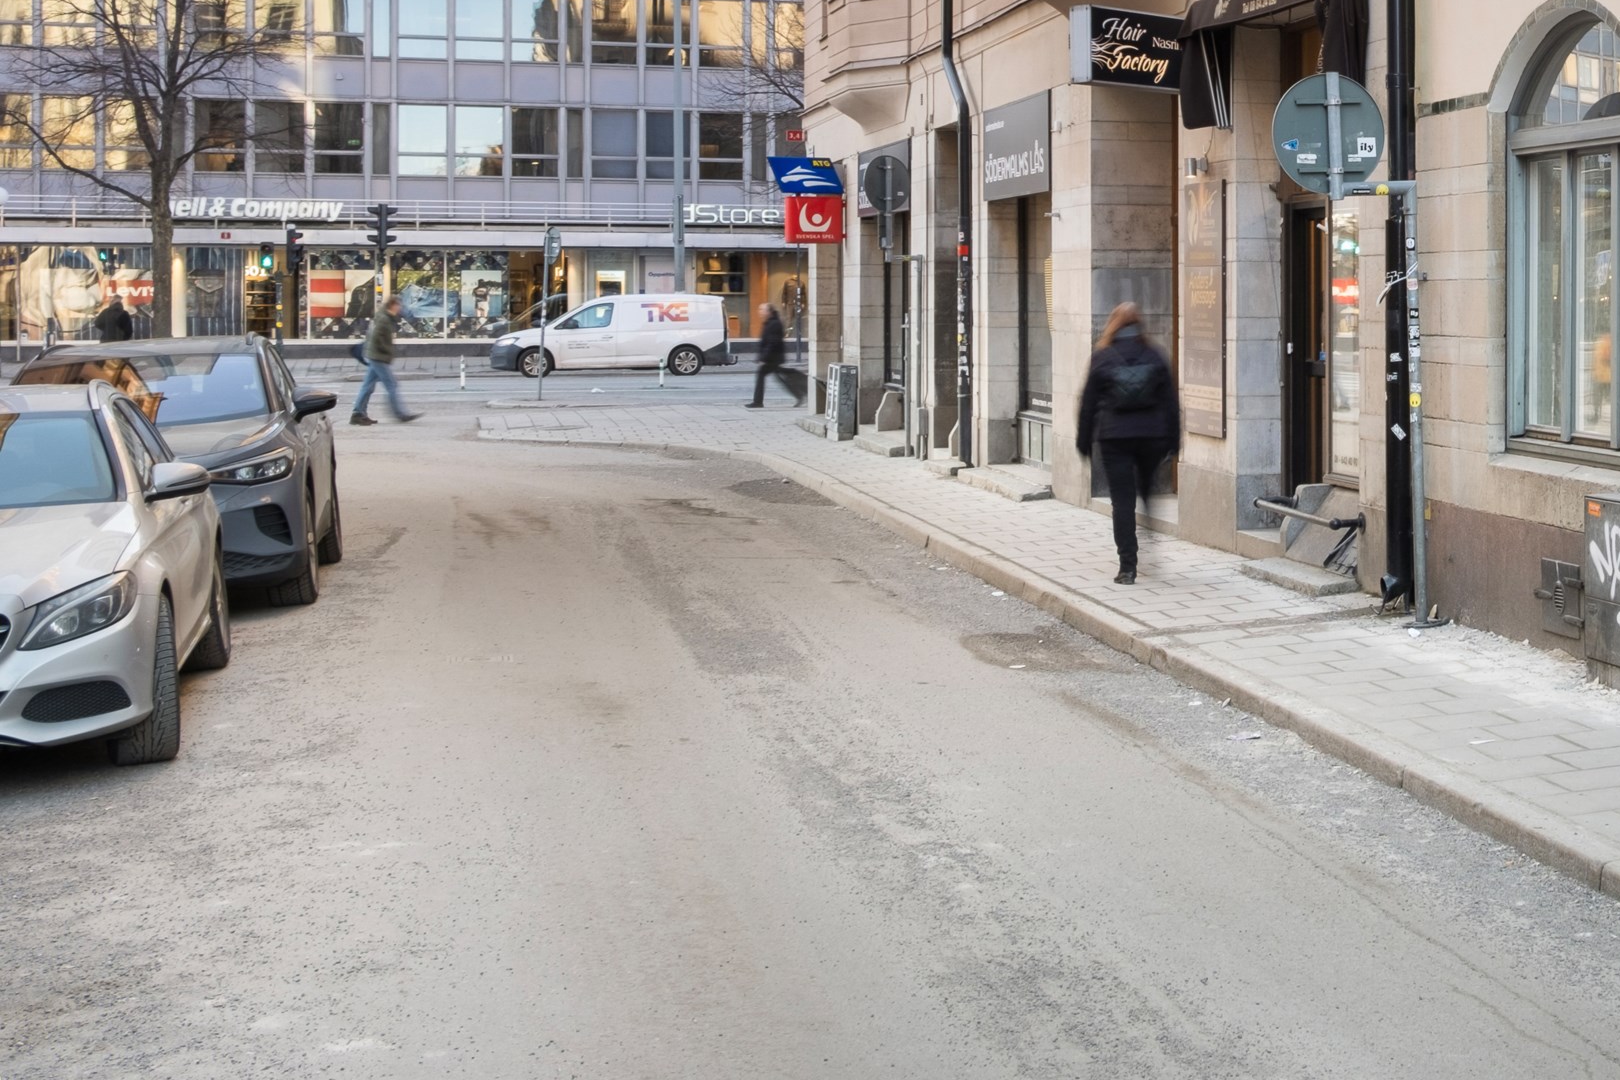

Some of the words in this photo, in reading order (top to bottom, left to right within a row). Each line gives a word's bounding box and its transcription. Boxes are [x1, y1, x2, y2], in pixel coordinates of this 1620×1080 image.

[1102, 18, 1147, 41] Hair
[1107, 45, 1169, 83] Factory
[1360, 143, 1374, 153] ily
[985, 151, 1029, 183] SÖDERMALMS
[1029, 139, 1044, 174] LÅS
[208, 197, 226, 217] &
[230, 198, 344, 222] Company
[641, 303, 689, 323] TKE
